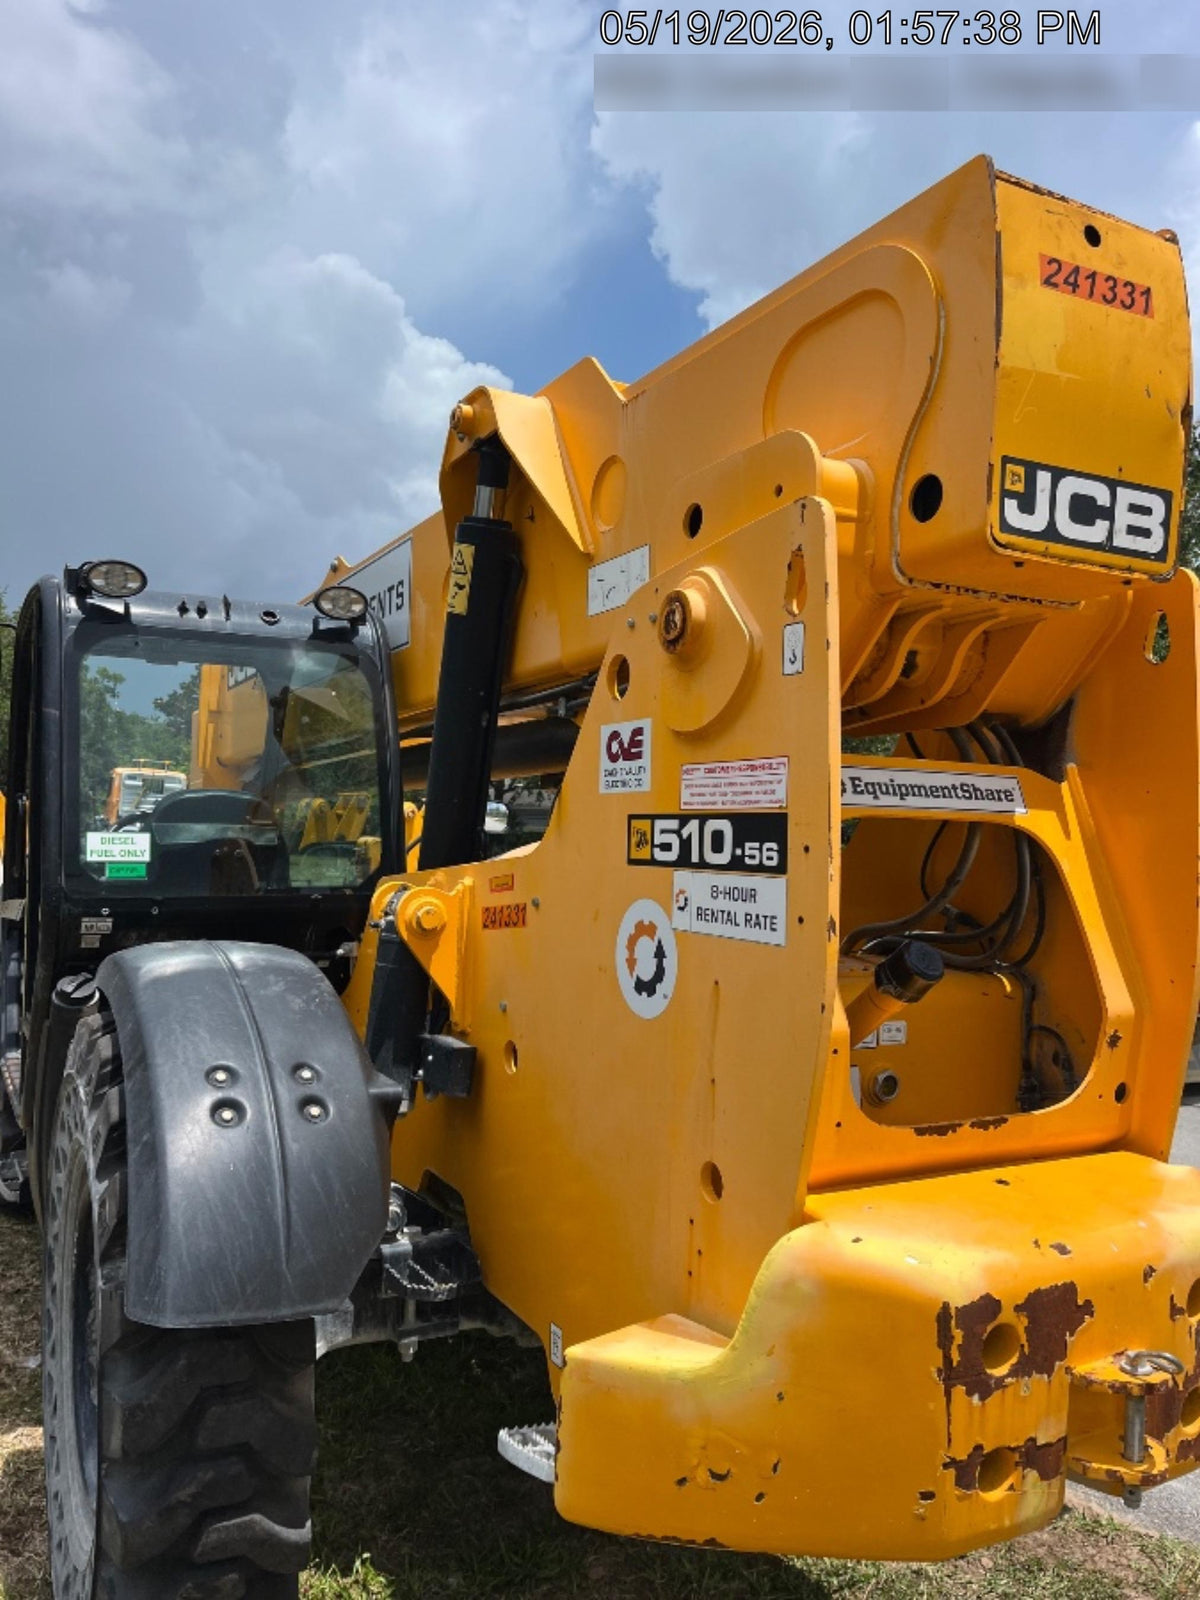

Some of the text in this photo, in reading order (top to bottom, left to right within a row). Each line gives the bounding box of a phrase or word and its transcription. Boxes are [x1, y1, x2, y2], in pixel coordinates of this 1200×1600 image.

[1042, 257, 1152, 315] 241331
[1003, 469, 1166, 555] JCB
[848, 776, 1015, 803] EquipmentShare
[90, 849, 146, 858] FUEL ONLY
[100, 836, 136, 845] DIESEL
[710, 884, 757, 904] 8-HOUR
[482, 903, 527, 929] 241331
[696, 906, 778, 932] RENTAL RATE
